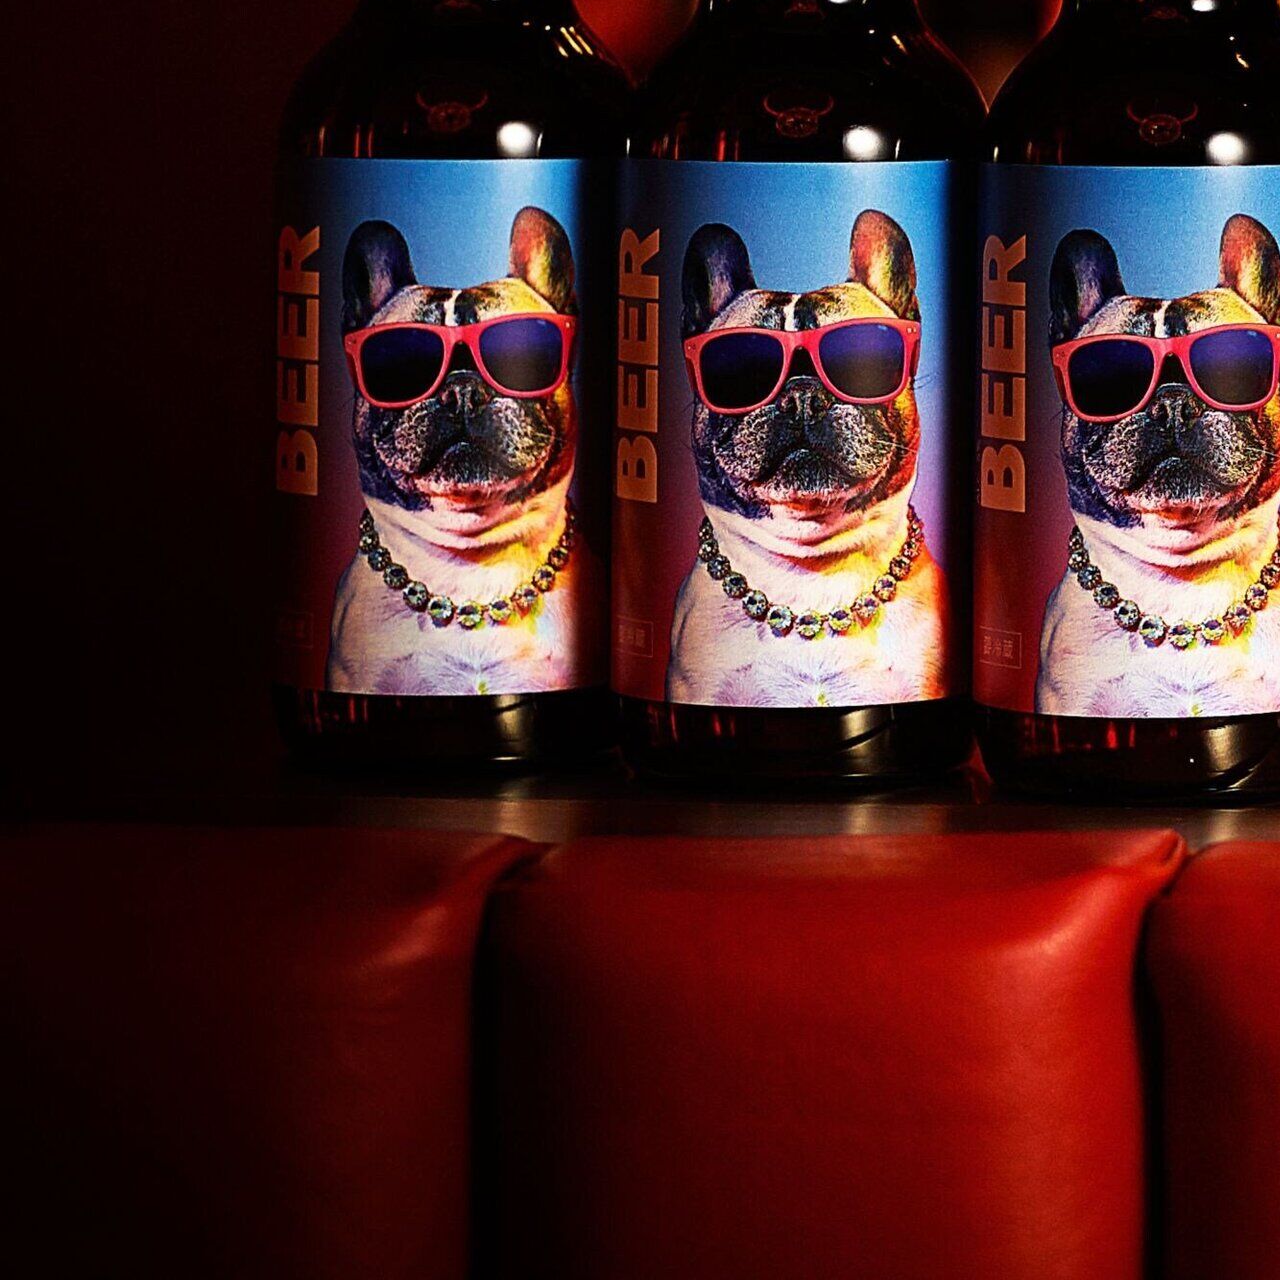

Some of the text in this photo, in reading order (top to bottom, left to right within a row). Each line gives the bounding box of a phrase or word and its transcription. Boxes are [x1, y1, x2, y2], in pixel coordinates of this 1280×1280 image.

[275, 225, 321, 496] BEER
[616, 226, 661, 503] BEER
[980, 234, 1027, 513] BEER
